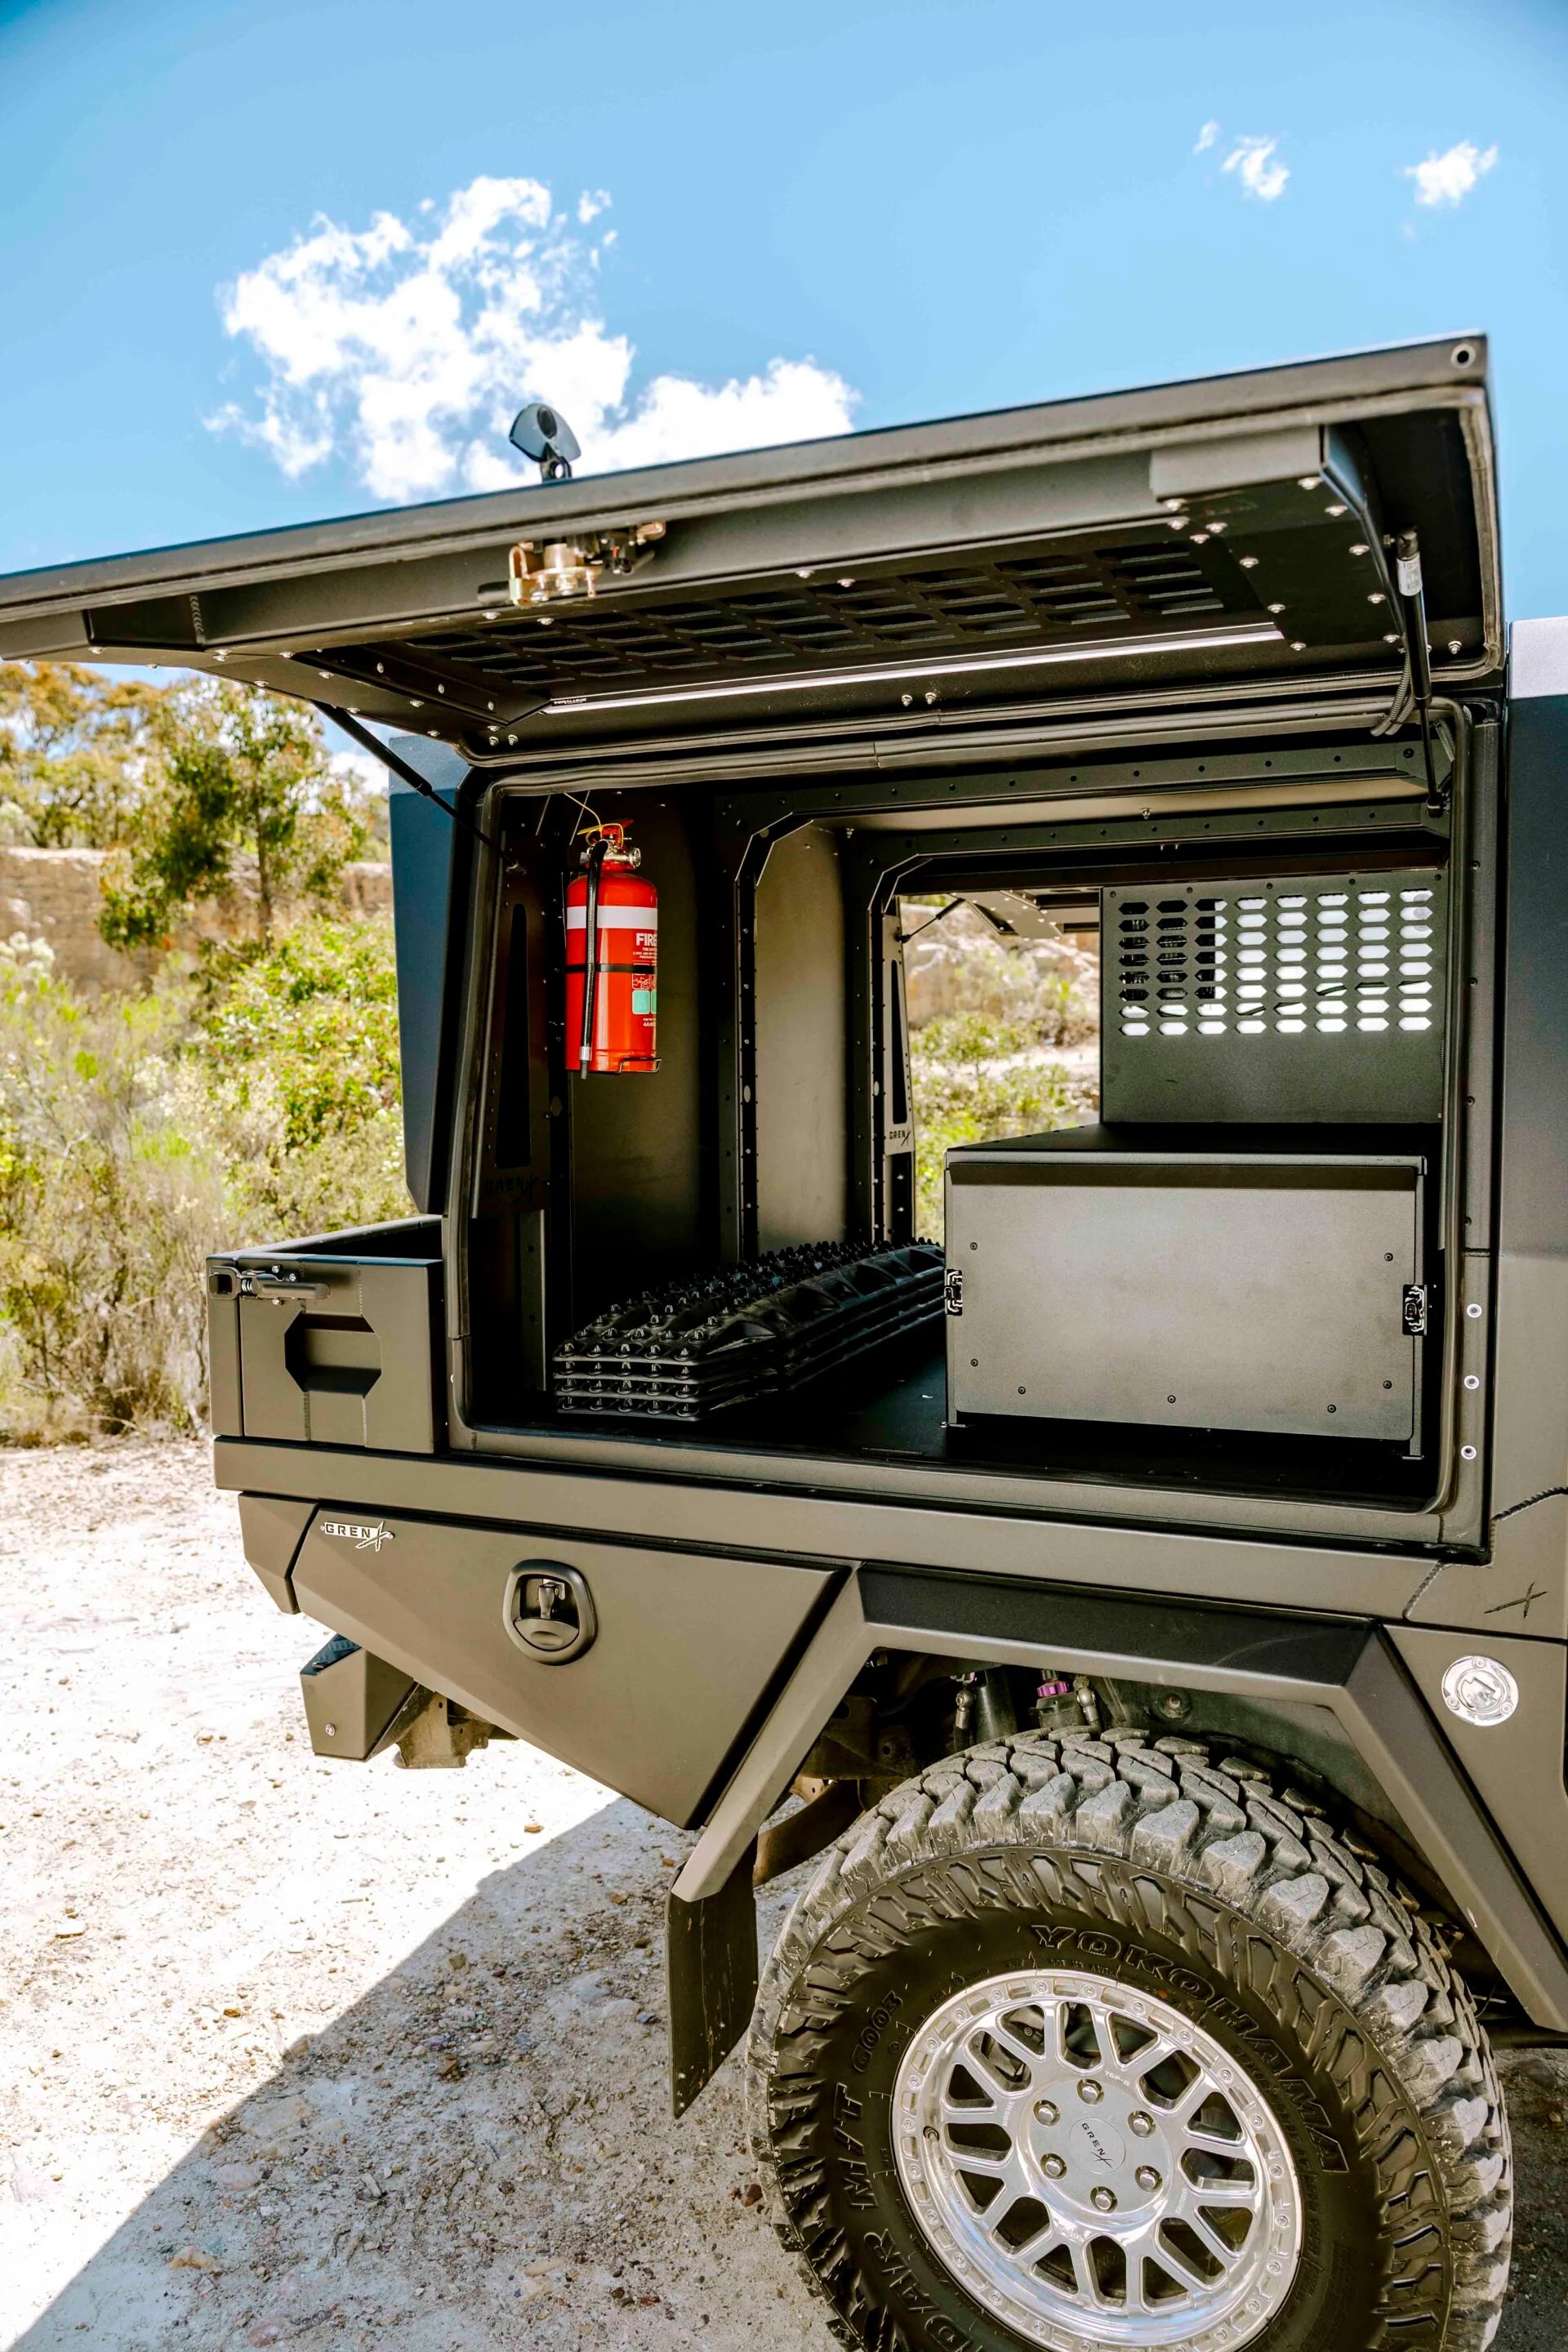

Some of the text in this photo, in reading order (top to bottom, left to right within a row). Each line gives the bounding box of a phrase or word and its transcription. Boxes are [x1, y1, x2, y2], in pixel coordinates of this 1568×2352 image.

[635, 933, 657, 947] FIRE
[325, 1521, 387, 1552] GRENX
[852, 1990, 904, 2073] G003
[1031, 1925, 1349, 2172] YOKOHAMA
[1081, 2123, 1114, 2169] GRENX
